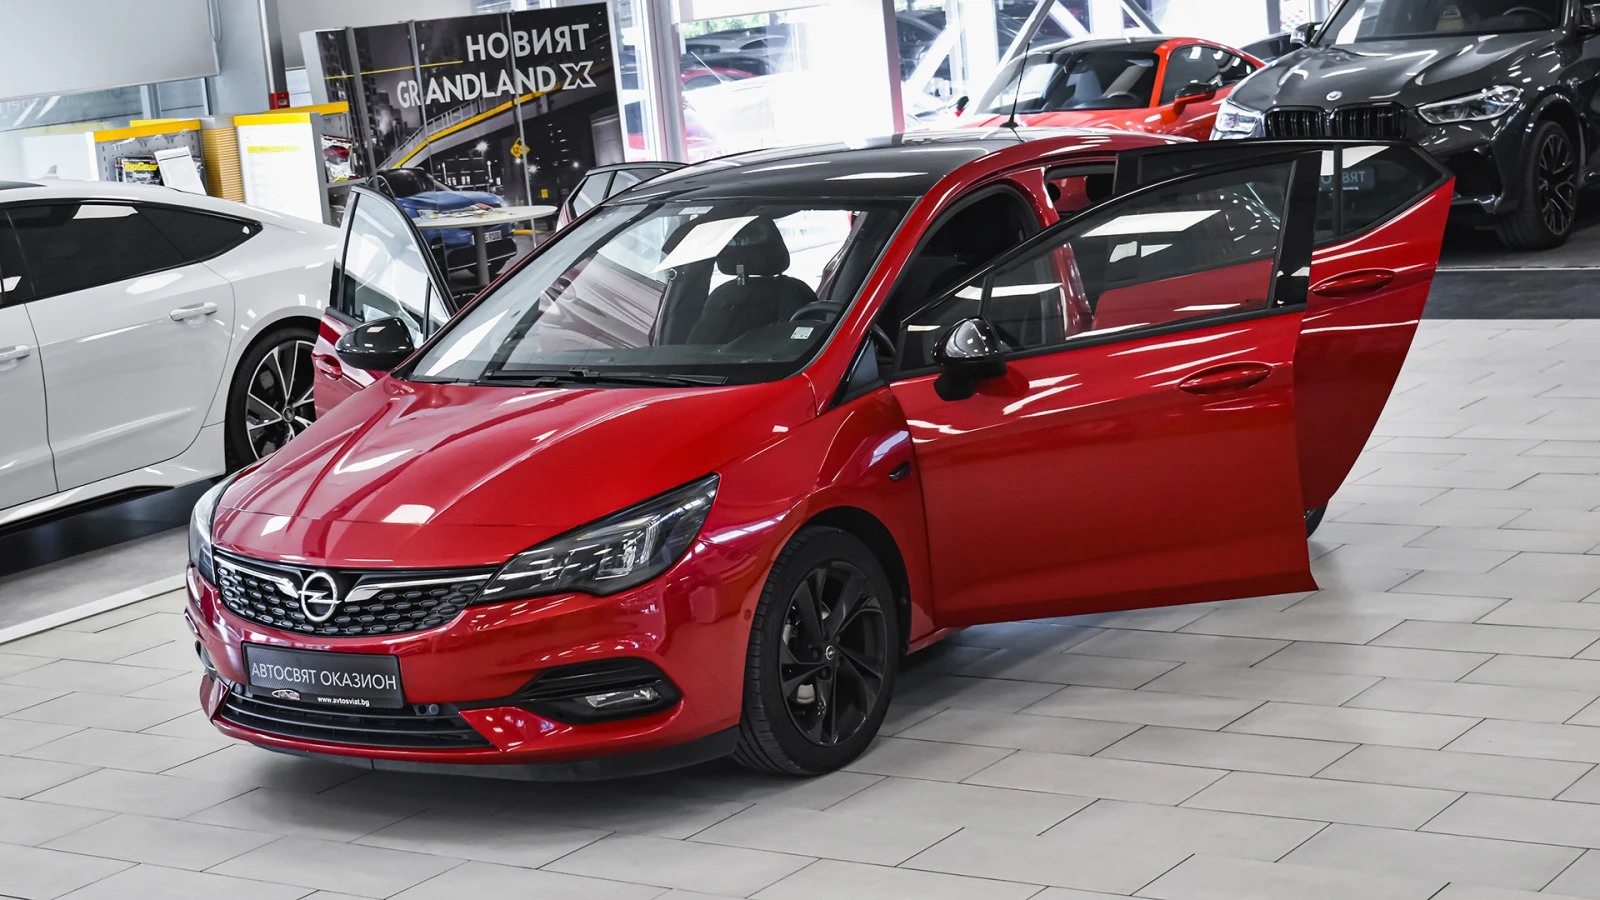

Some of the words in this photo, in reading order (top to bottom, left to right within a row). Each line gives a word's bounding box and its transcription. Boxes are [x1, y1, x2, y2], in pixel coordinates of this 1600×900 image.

[466, 23, 590, 62] НОВИЯТ
[396, 65, 557, 109] GRANDLAND
[559, 60, 597, 91] X
[251, 662, 317, 685] АВТОСВЯТ
[320, 670, 397, 690] ОКАЗИОН
[317, 696, 370, 707] www.avtosviat.bg
